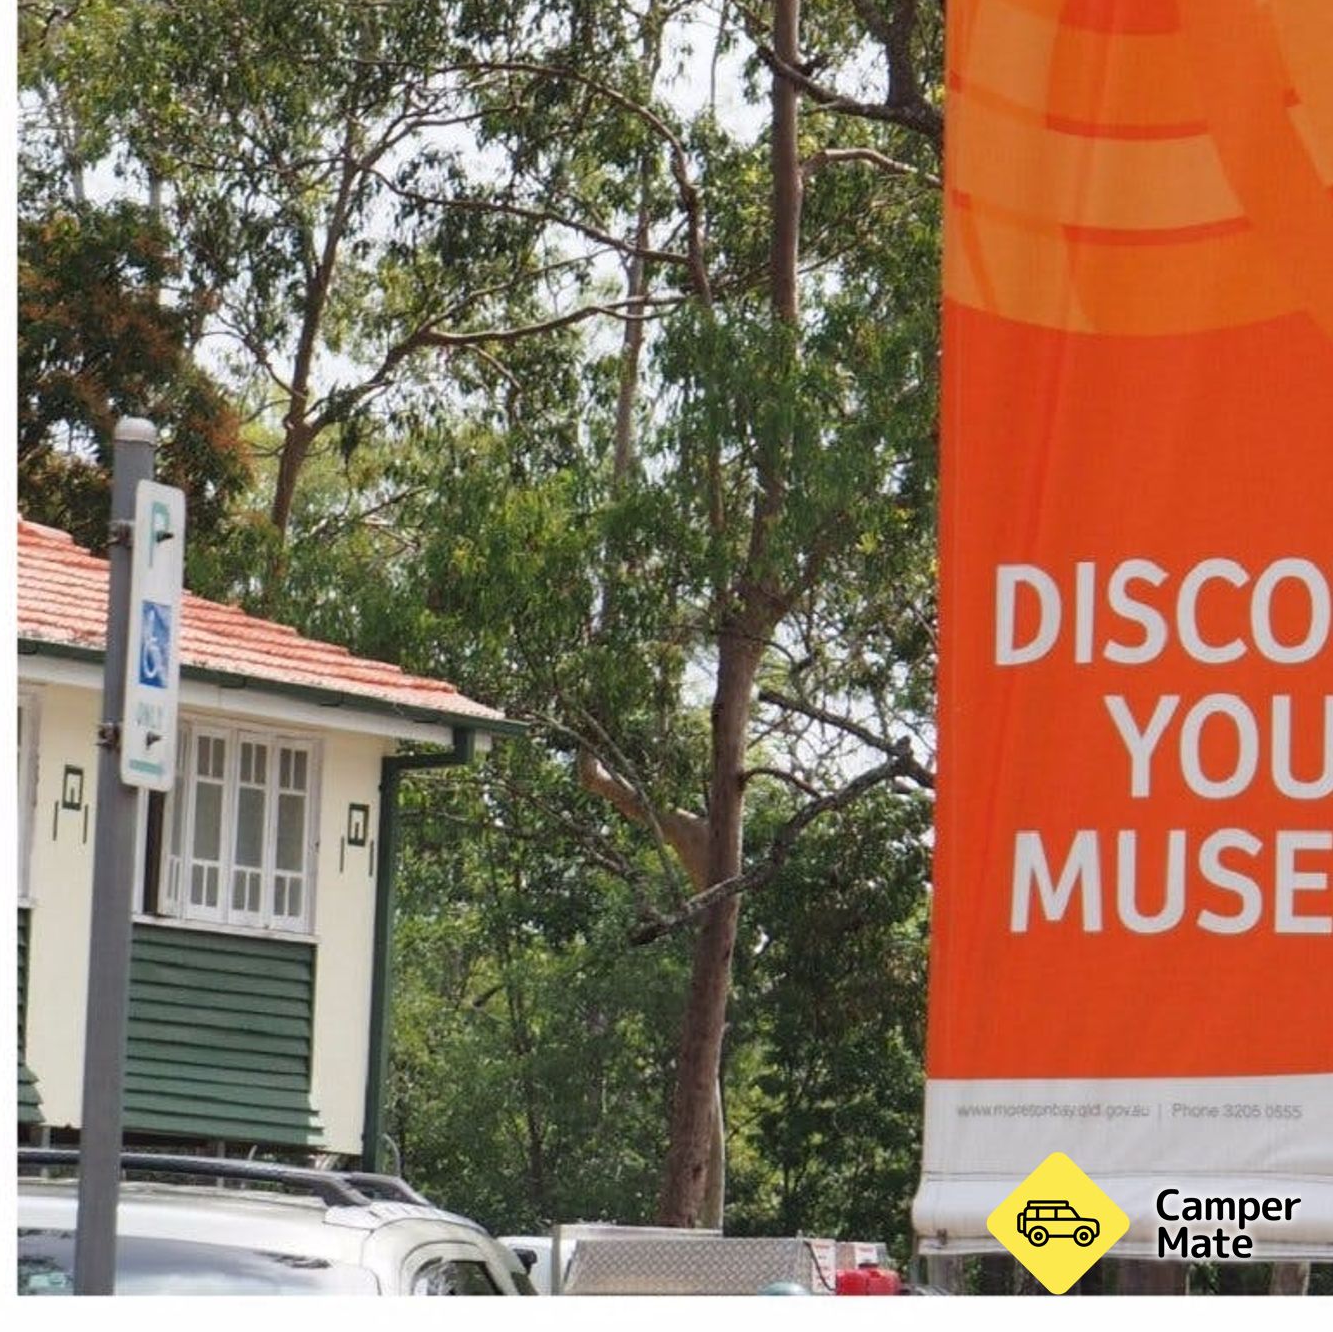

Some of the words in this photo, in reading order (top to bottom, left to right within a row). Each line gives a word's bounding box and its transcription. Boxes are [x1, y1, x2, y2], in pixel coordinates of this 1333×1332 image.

[147, 501, 170, 567] P
[995, 557, 1331, 666] DISCO
[1103, 692, 1333, 800] YOU
[1010, 828, 1333, 934] MUSE
[1171, 1103, 1220, 1118] Phone
